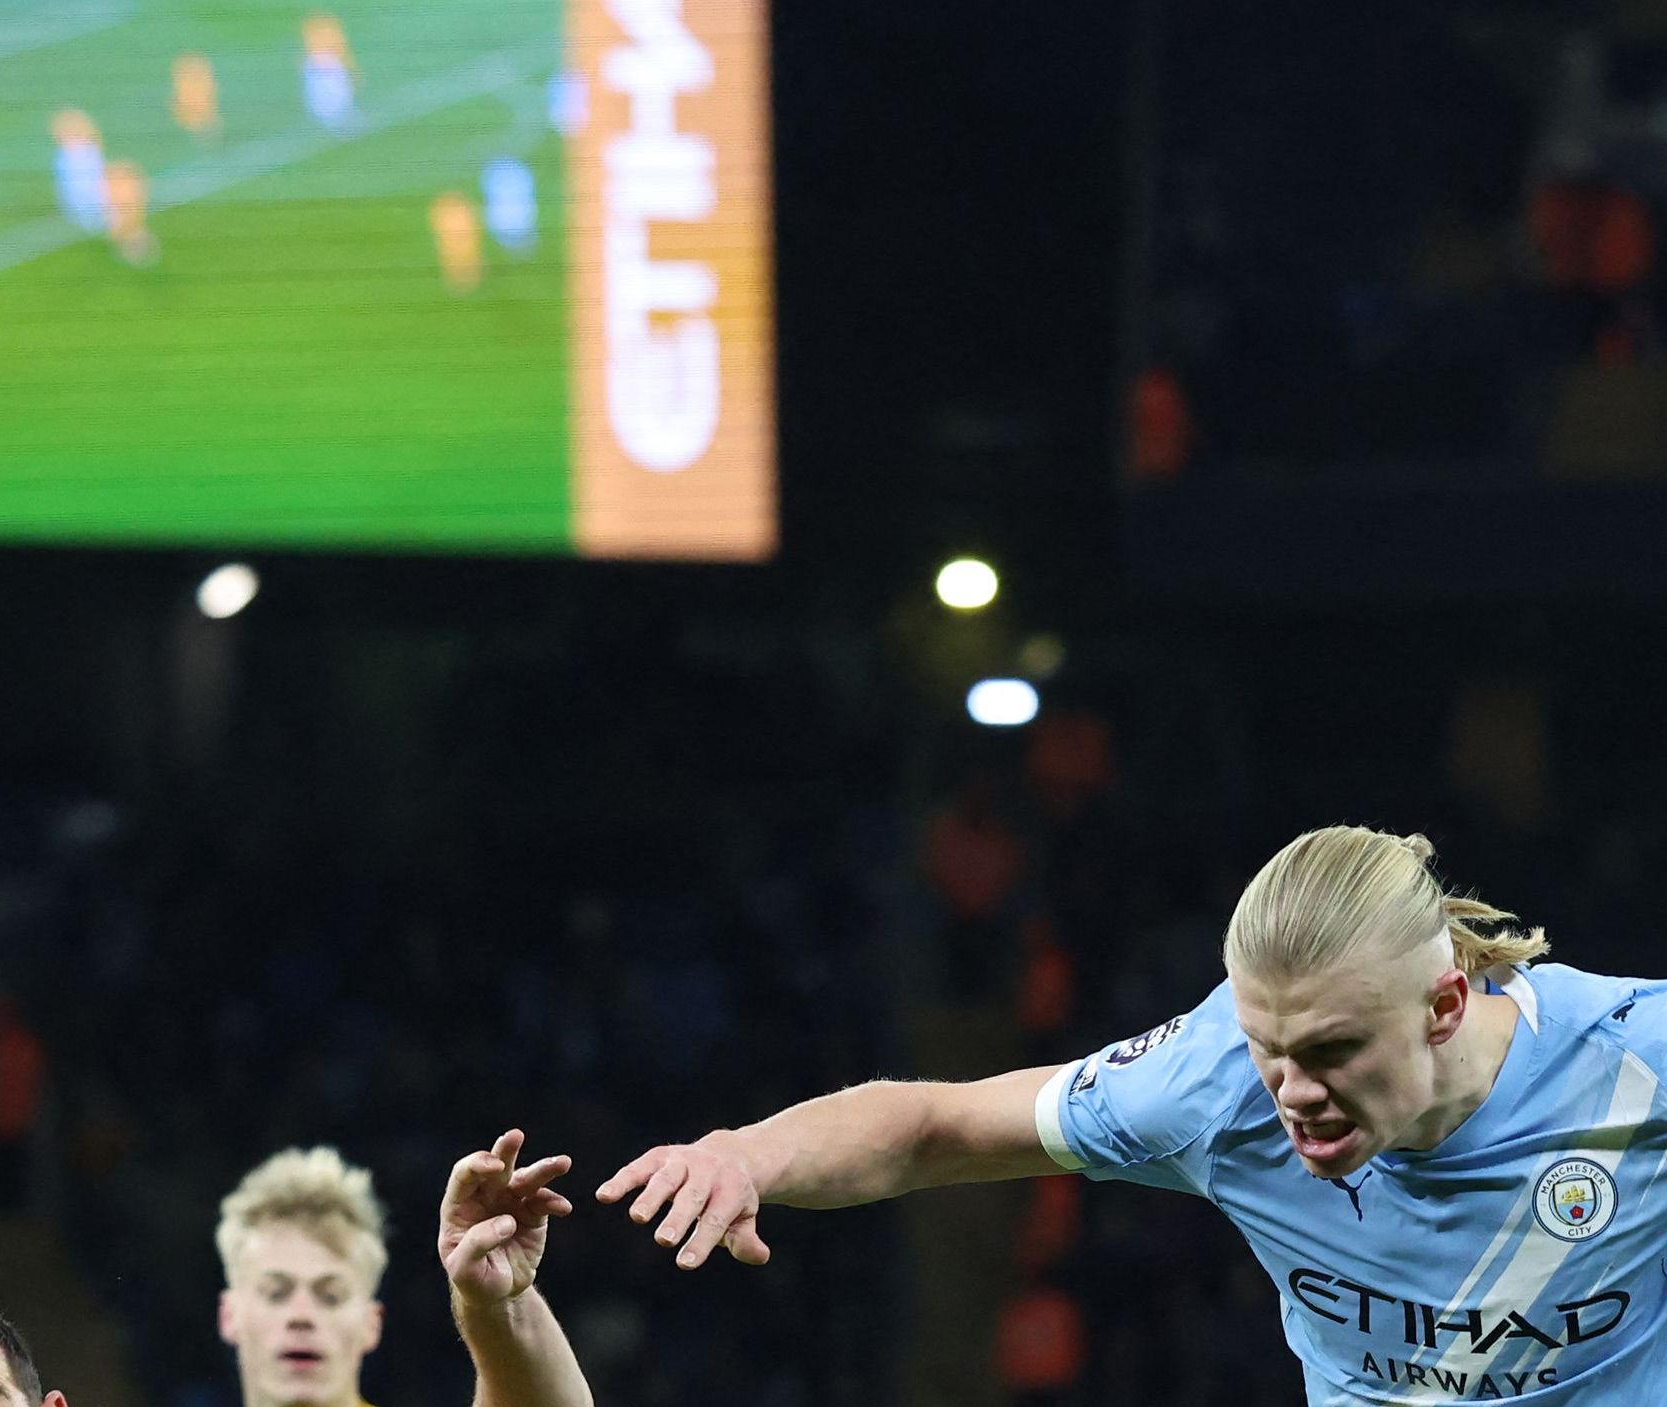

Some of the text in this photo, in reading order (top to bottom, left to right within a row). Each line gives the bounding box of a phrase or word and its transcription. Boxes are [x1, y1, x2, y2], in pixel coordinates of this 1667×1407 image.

[1540, 1164, 1606, 1194] MANCHESTER
[1567, 1226, 1592, 1237] CITY
[1288, 1267, 1631, 1355] ETIHAD
[1362, 1351, 1559, 1400] AIRWAYS
